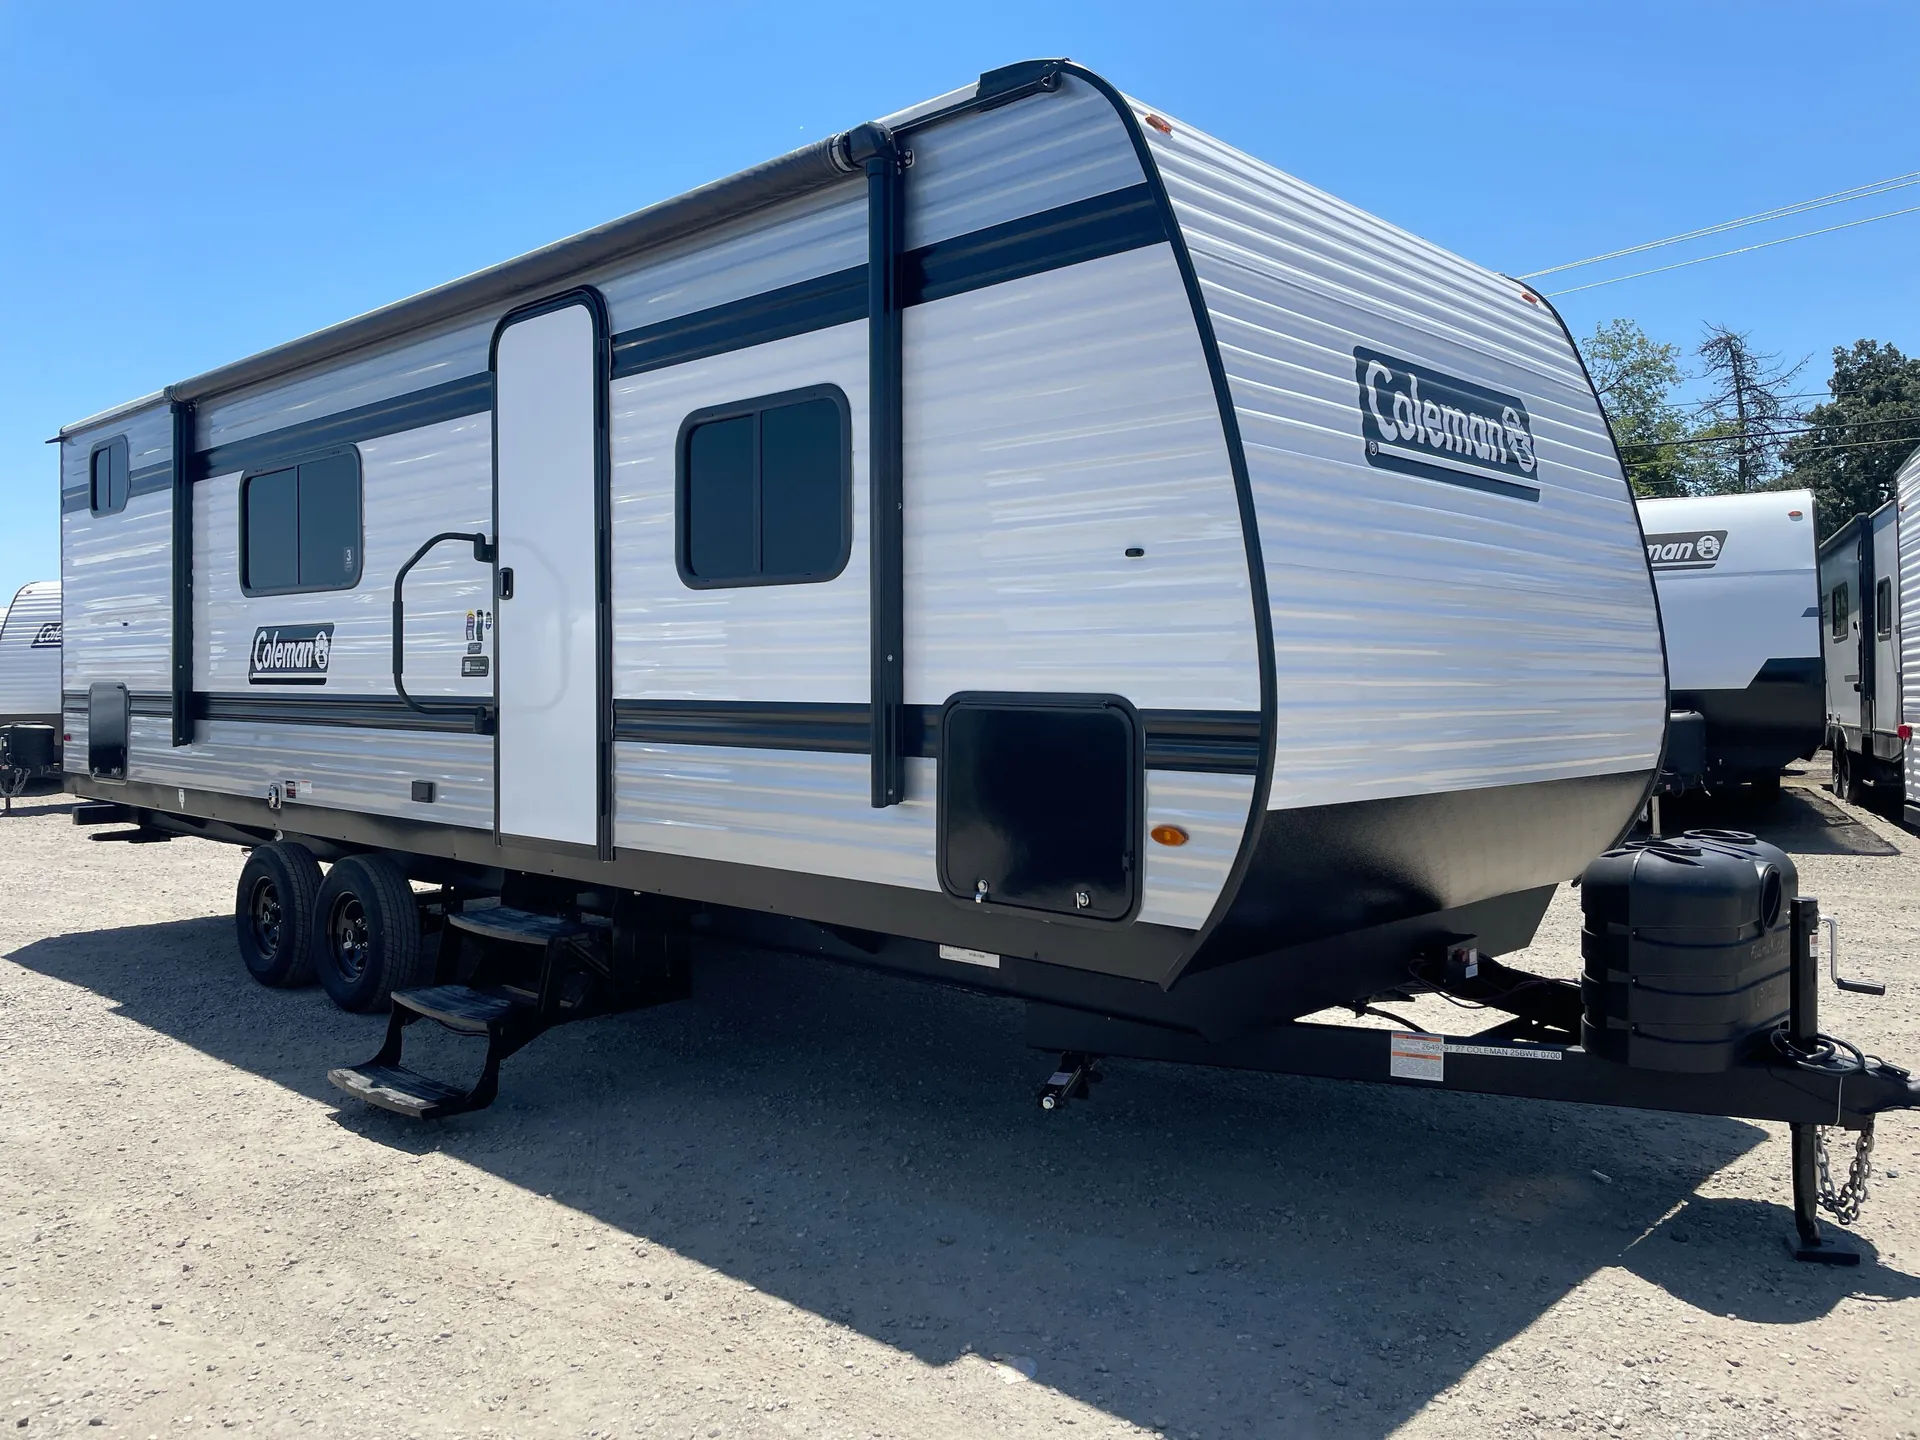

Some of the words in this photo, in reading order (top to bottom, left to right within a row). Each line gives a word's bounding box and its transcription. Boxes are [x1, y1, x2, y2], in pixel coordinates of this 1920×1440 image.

[1365, 359, 1507, 465] Coleman
[346, 549, 352, 561] 3
[254, 630, 314, 671] Coleman
[1421, 1044, 1452, 1053] 2649291
[1455, 1045, 1464, 1053] 27
[1467, 1046, 1508, 1056] COLEMAN
[1510, 1050, 1539, 1058] 25BWE
[1540, 1051, 1560, 1060] 0700
